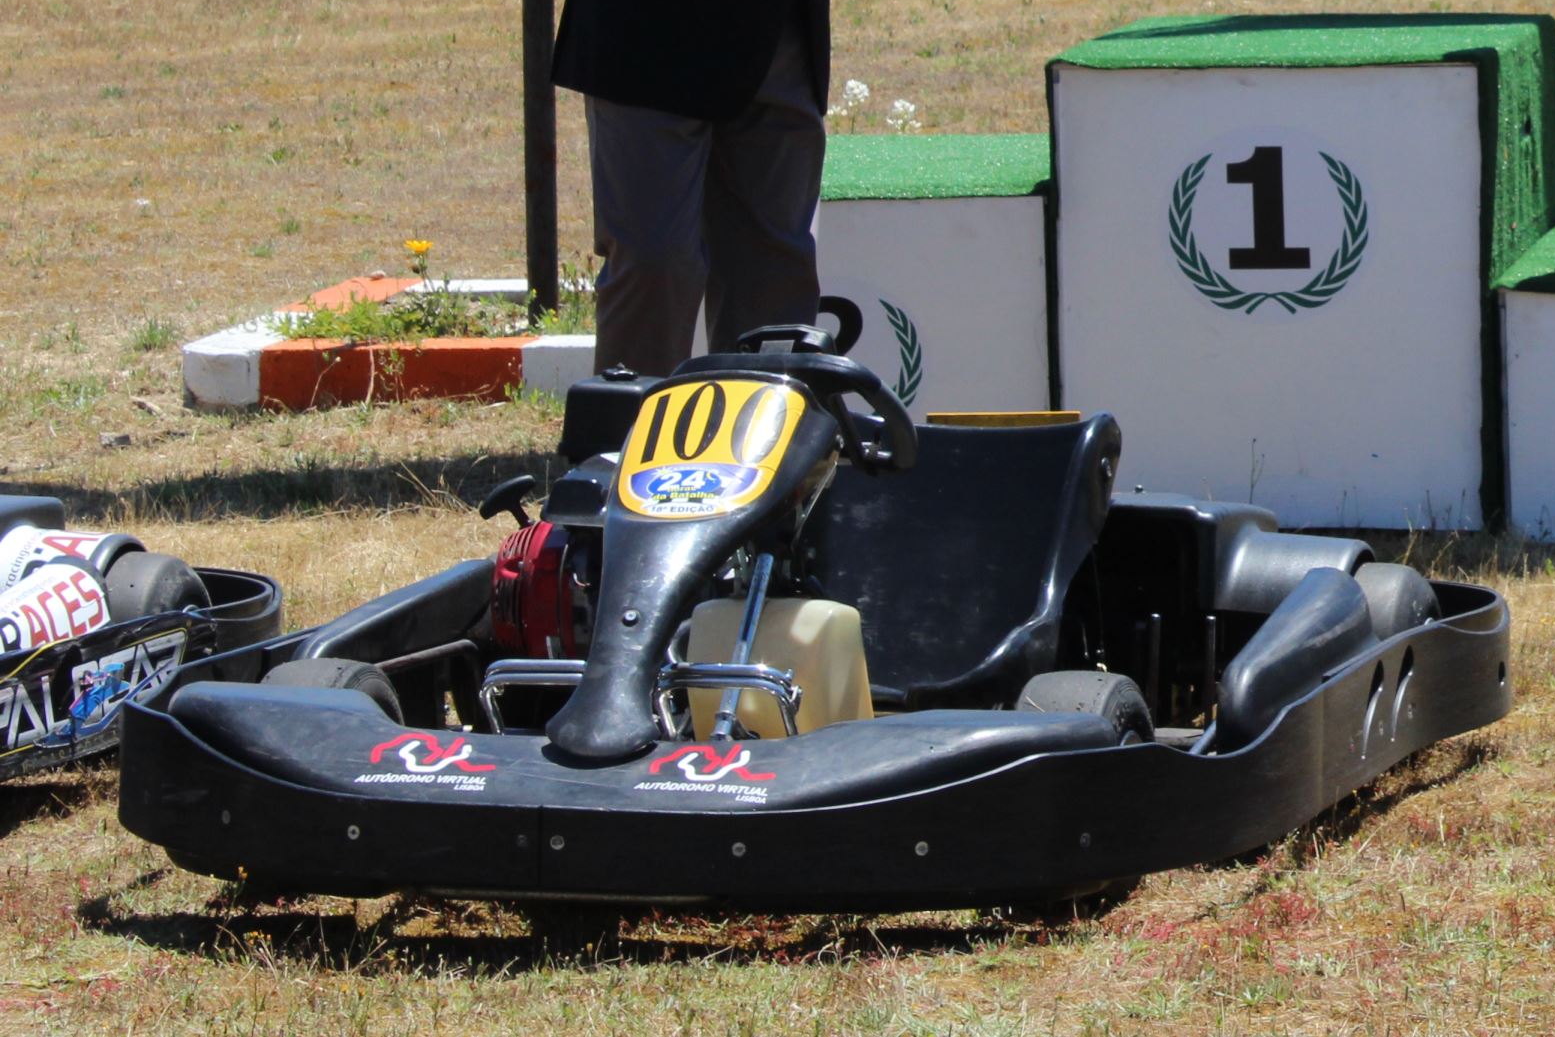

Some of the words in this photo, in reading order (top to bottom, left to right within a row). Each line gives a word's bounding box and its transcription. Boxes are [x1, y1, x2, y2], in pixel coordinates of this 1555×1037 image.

[1226, 145, 1311, 270] 1
[640, 380, 788, 465] 100
[657, 469, 707, 492] 24
[354, 772, 436, 784] AUTÓDROMO
[436, 775, 487, 785] VIRTUAL
[453, 784, 485, 792] LISBOA
[633, 781, 715, 793] AUTÓDROMO
[716, 784, 769, 797] VIRTUAL
[735, 794, 767, 805] LISBOA
